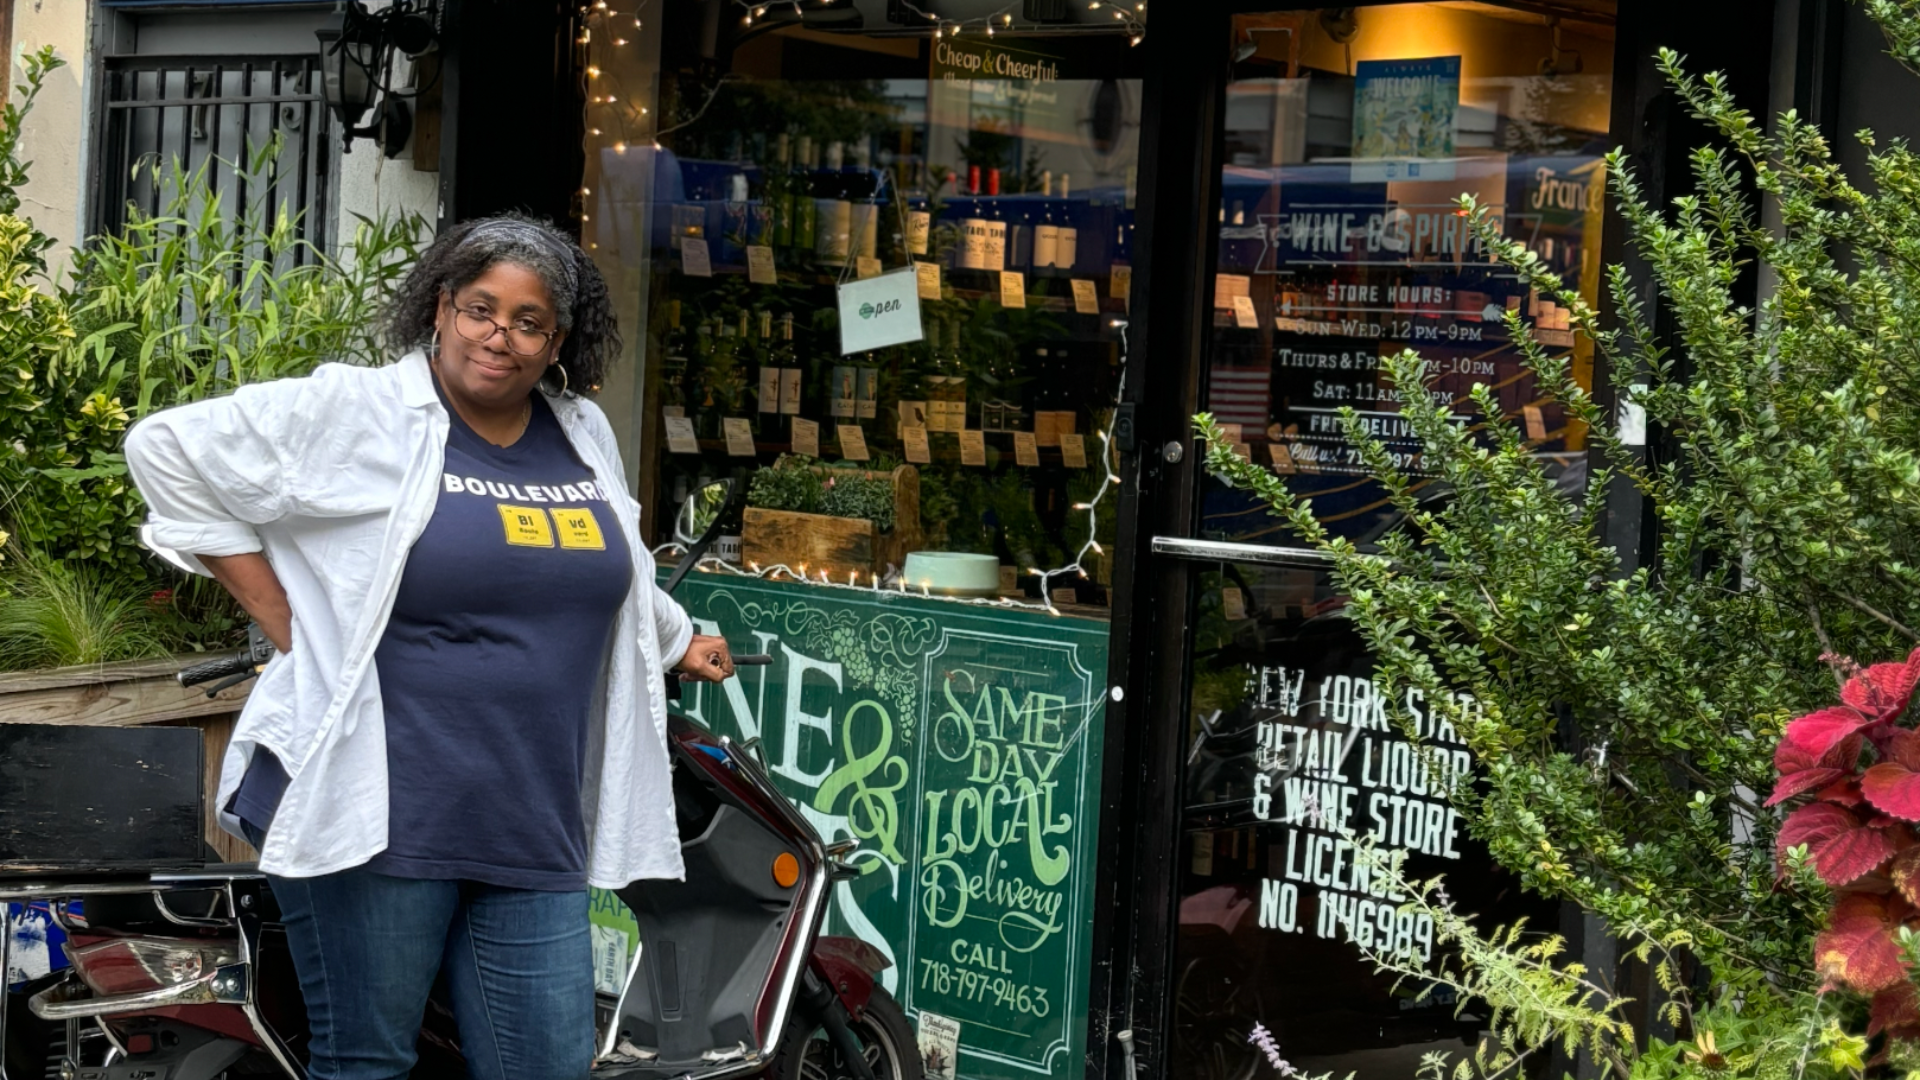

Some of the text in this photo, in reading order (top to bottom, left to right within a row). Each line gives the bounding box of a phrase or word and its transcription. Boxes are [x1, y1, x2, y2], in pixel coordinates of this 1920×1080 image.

[936, 42, 980, 73] Cheap
[982, 49, 994, 74] &
[1373, 74, 1441, 98] WELCOME
[1384, 64, 1431, 74] ALWAYS
[1531, 167, 1603, 213] France
[1290, 212, 1502, 254] WINE & SPIRIT
[1327, 284, 1452, 304] STORE HOURS:
[1312, 381, 1351, 399] SAT:
[1289, 442, 1318, 462] Call
[934, 669, 1067, 762] SAME
[1319, 675, 1391, 733] YORK
[1406, 686, 1484, 746] STAT
[967, 739, 1065, 793] DAY
[1255, 721, 1349, 783] RETAIL
[814, 699, 909, 875] &
[922, 777, 1072, 886] LOCAL
[1253, 773, 1461, 860] & WINE STORE
[1285, 829, 1409, 902] LICENSE
[921, 848, 1064, 953] Delivery
[1258, 877, 1434, 963] NO. 1146989
[951, 938, 1013, 975] CALL
[920, 957, 1050, 1018] 718-797-9463
